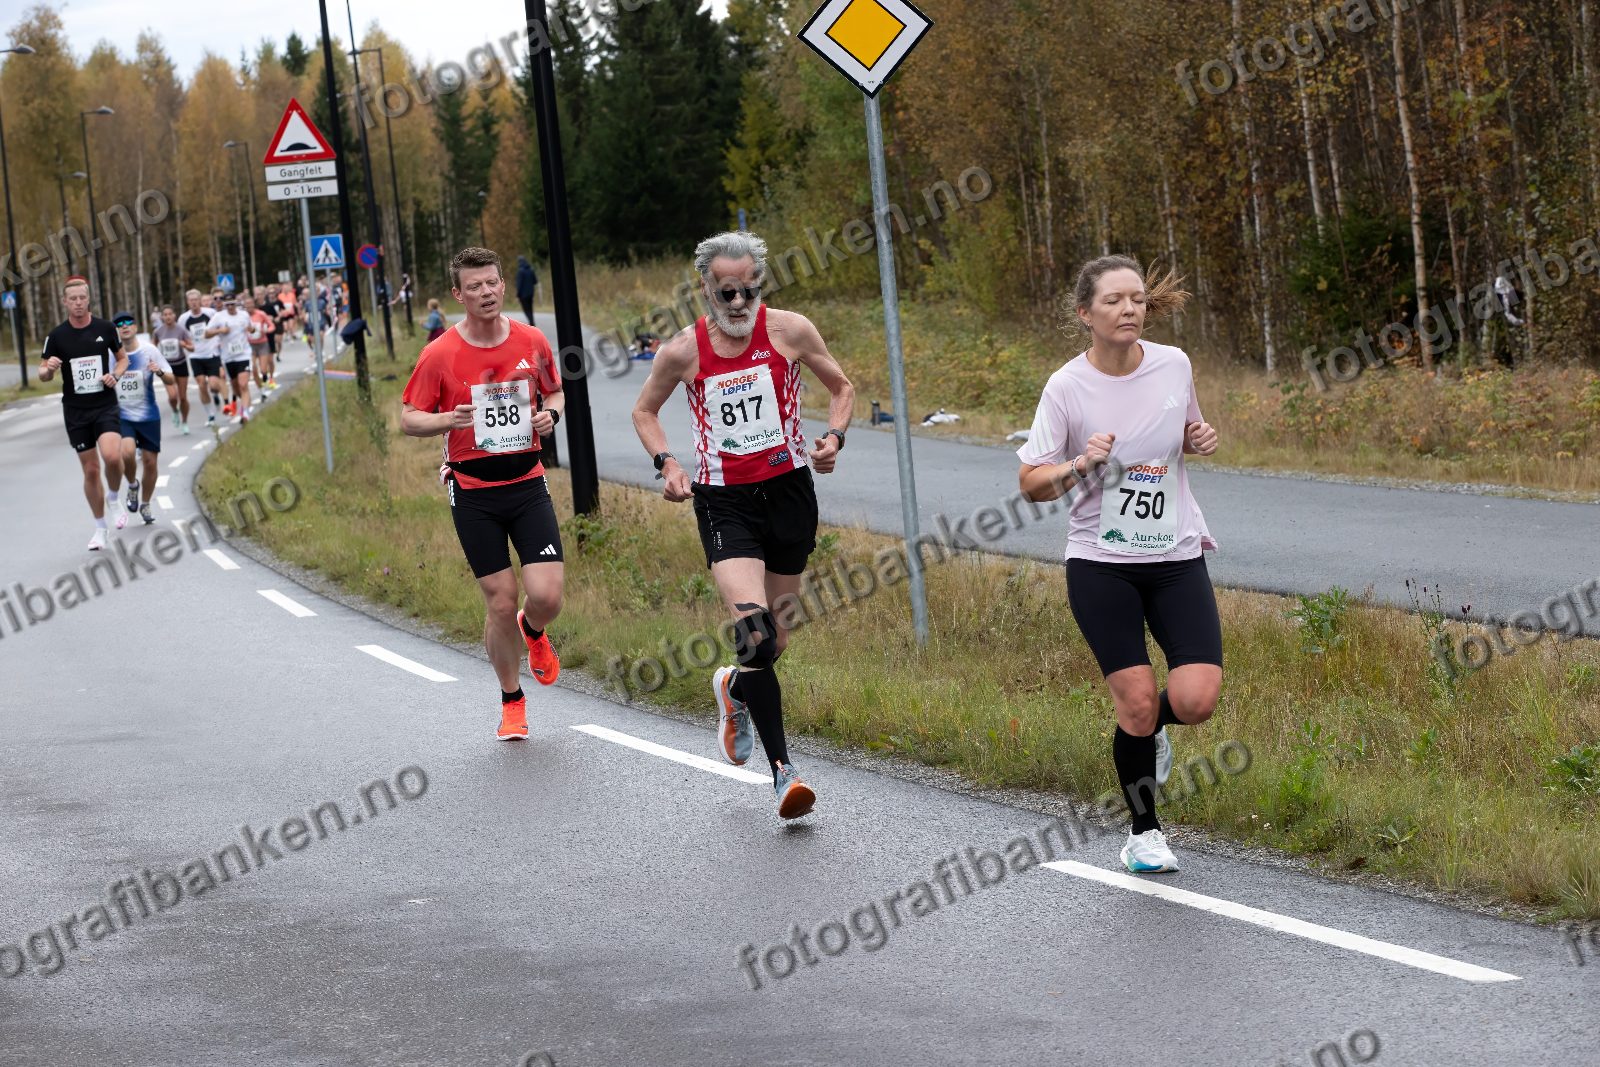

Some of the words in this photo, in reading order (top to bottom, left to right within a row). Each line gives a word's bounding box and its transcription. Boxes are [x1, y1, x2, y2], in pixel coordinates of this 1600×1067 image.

[280, 167, 322, 178] Gangfelt
[283, 187, 291, 196] 0
[300, 186, 305, 195] 1
[307, 185, 322, 194] km
[78, 368, 97, 381] 367
[717, 373, 758, 389] NORGES
[483, 385, 520, 396] NORGES
[722, 382, 754, 397] LØPET
[485, 404, 520, 428] 558
[720, 394, 762, 427] 817
[500, 434, 531, 444] Aurskog
[743, 428, 780, 444] Aurskog
[1126, 464, 1168, 475] NORGES
[1127, 472, 1163, 484] LØPET
[1119, 487, 1165, 520] 750
[1131, 531, 1174, 544] Aurskog
